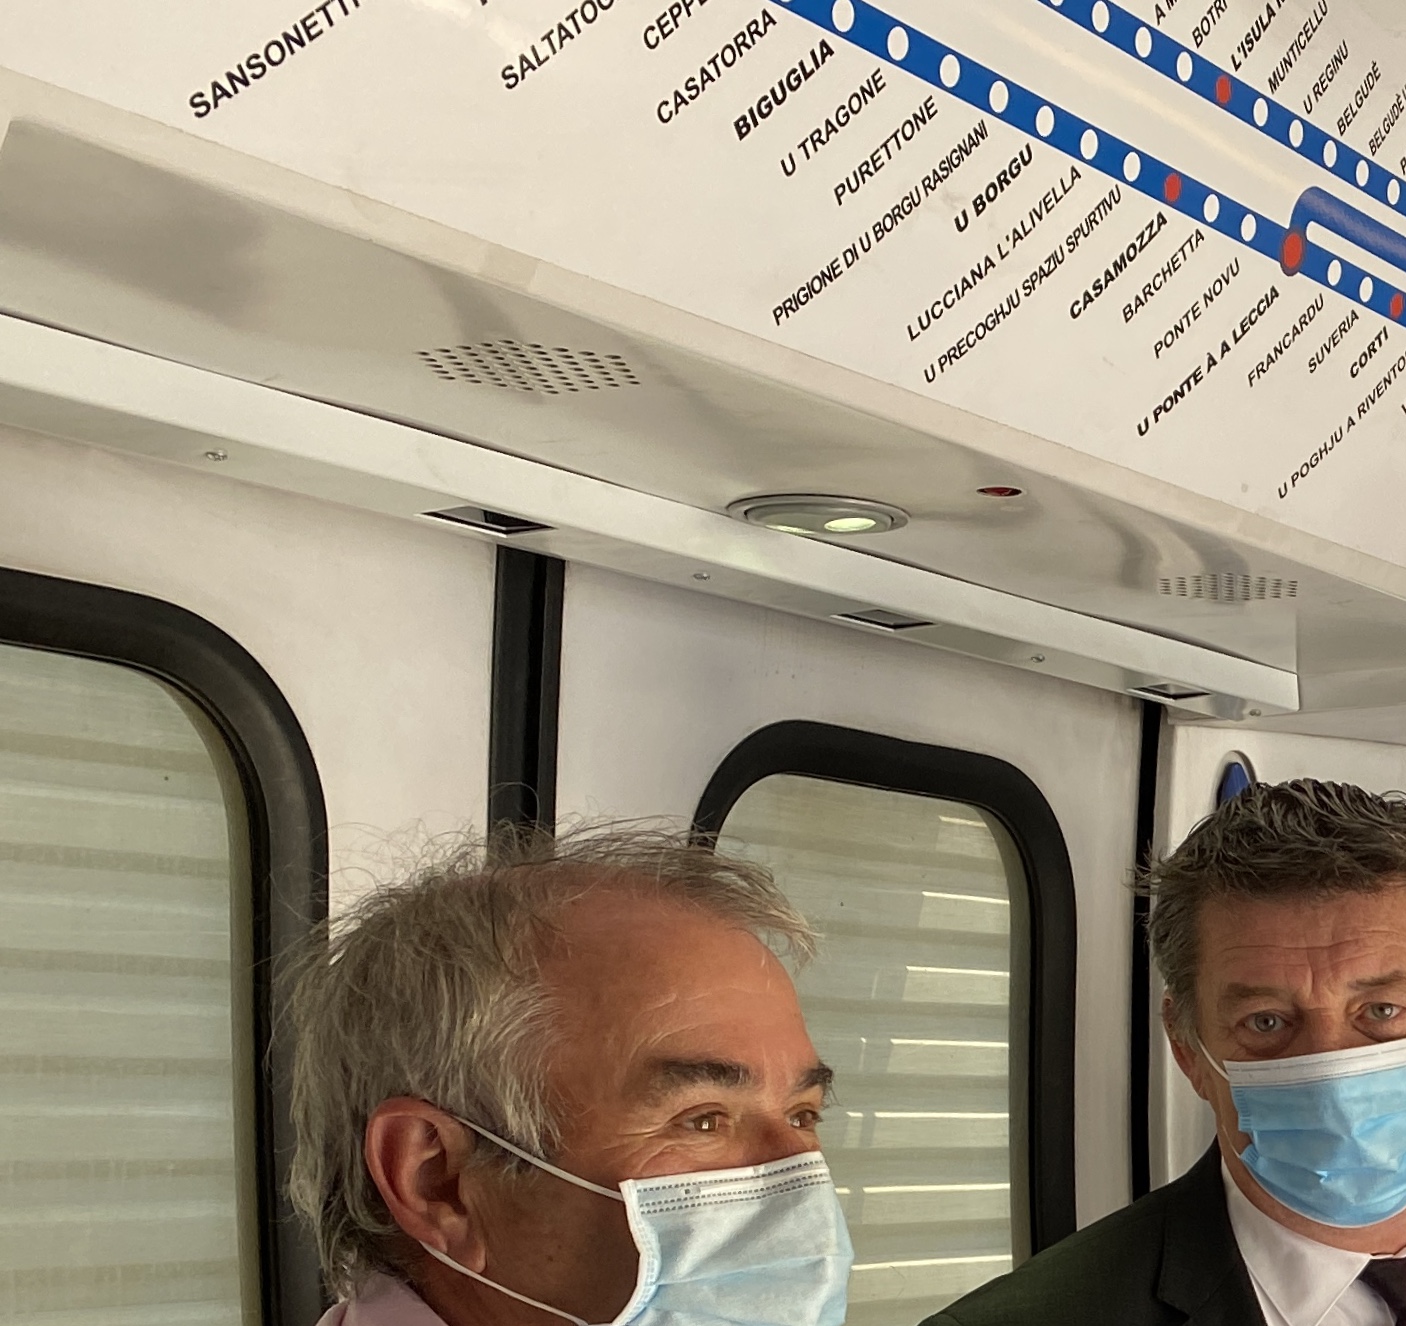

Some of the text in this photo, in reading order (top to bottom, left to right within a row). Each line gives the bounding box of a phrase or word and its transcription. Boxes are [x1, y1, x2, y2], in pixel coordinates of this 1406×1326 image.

[644, 0, 707, 49] CEPP
[657, 8, 777, 123] CASATORRA
[1231, 3, 1276, 72] L'ISULA
[1268, 0, 1327, 94] MUNTICELLU
[734, 39, 834, 141] BIGUGLIA
[781, 68, 886, 177] U TRAGONE
[1303, 39, 1348, 114] U REGINU
[834, 95, 938, 206] PURETTONE
[955, 143, 1032, 233] U BORGU
[773, 119, 988, 326] PRIGIONE DI U BORGU RASIGNANI
[907, 165, 1081, 341] LUCCIANA L'ALIVELLA
[1070, 212, 1167, 319] CASAMOZZA
[924, 184, 1121, 383] U PRECOGHJU SPAZIU SPURTIVU
[1123, 229, 1204, 323] BARCHETTA
[1154, 257, 1239, 359] PONTE NOVU
[1137, 417, 1149, 436] U
[1153, 366, 1203, 423] PONTE
[1221, 340, 1231, 360] A
[1232, 286, 1279, 345] LECCIA
[1248, 293, 1323, 387] FRANCARDU
[1309, 309, 1359, 373] SUVERIA
[1350, 326, 1388, 378] CORTI
[1278, 482, 1287, 499] U
[1291, 427, 1343, 487] POGHJU
[1347, 416, 1355, 432] A
